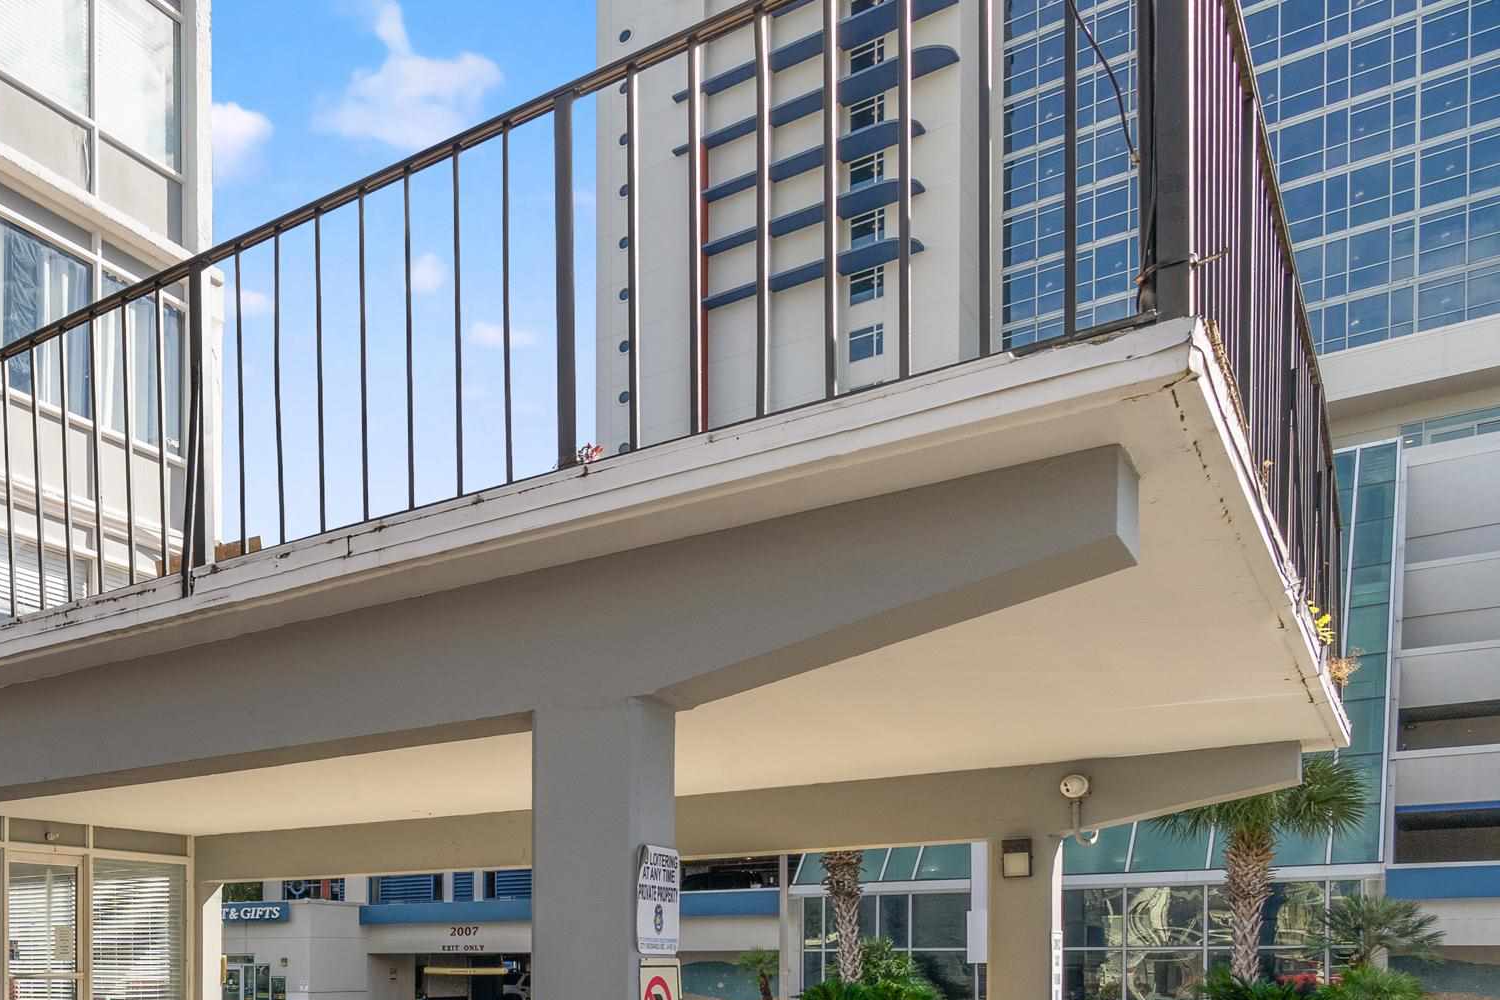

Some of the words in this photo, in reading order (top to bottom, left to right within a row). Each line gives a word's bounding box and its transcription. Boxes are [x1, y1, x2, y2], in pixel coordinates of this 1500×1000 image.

[650, 852, 678, 868] LOITERING
[643, 866, 650, 880] AT
[650, 867, 661, 882] ANY
[662, 869, 675, 883] TIME
[638, 883, 656, 902] PRIVATE
[657, 885, 678, 904] PROPERTY
[229, 907, 239, 919] &
[240, 906, 280, 919] GIFTS
[450, 926, 479, 936] 2007
